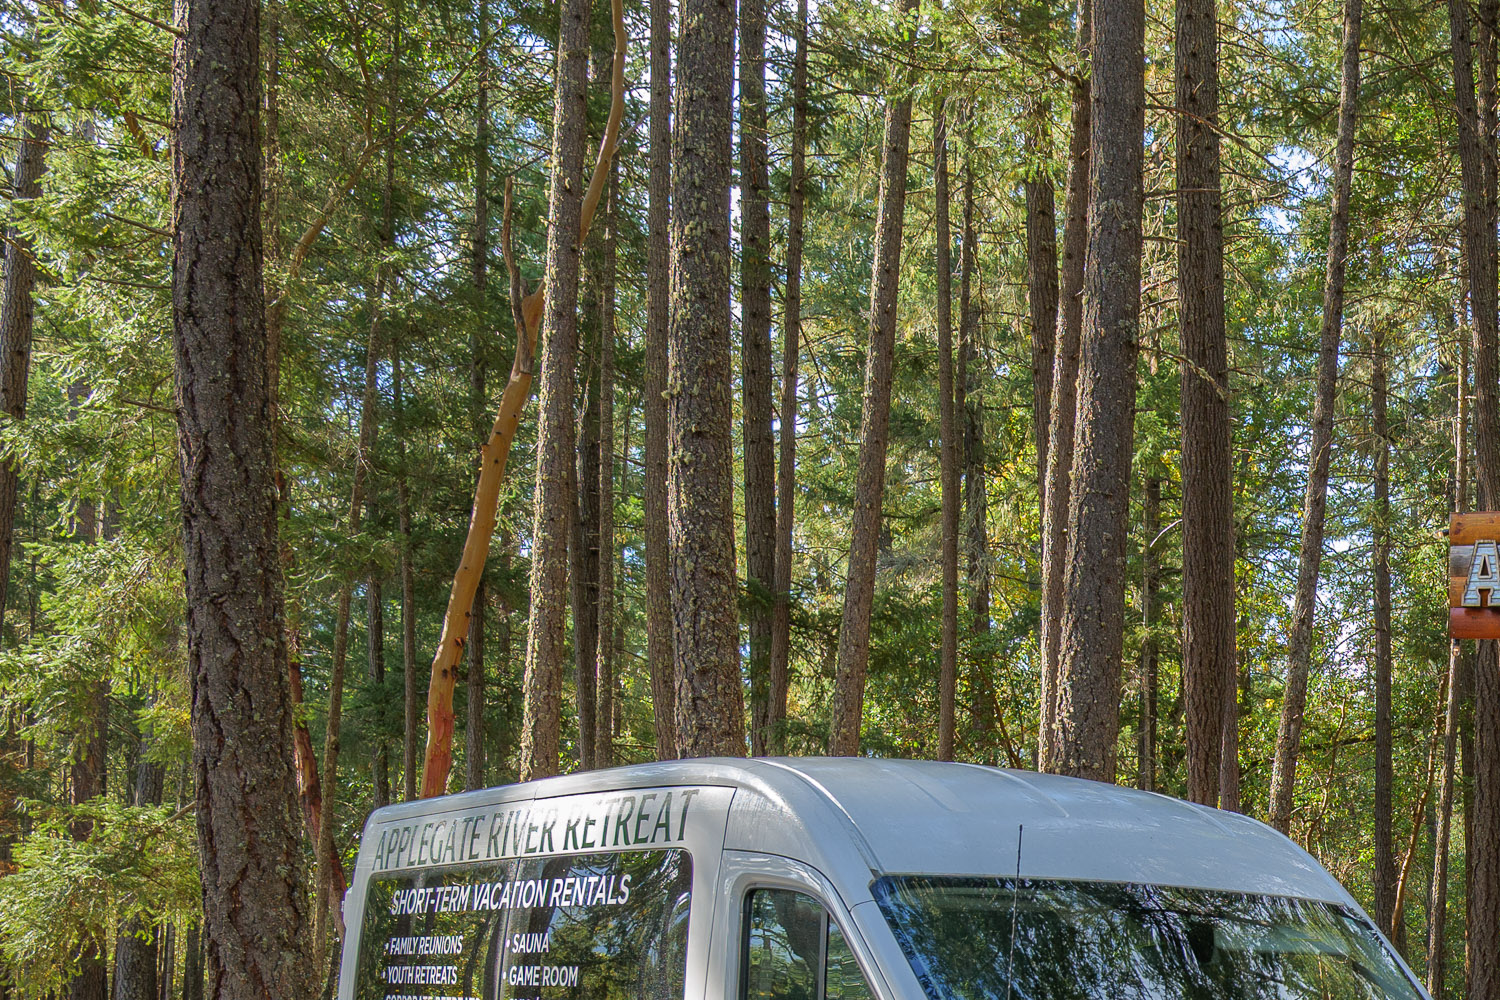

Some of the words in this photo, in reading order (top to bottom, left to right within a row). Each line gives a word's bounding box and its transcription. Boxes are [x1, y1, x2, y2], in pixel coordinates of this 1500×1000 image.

[372, 814, 485, 871] APPLEGATE
[486, 805, 557, 858] RIVER
[563, 789, 700, 851] RETREAT
[391, 883, 471, 915] SHORT-TERM
[472, 878, 547, 911] VACATION
[549, 874, 632, 907] RENTALS
[390, 936, 419, 955] FAMILY
[419, 935, 464, 954] REUNIONS
[512, 933, 549, 953] SAUNA
[387, 966, 413, 984] YOUTH
[414, 966, 458, 985] RETREATS
[509, 965, 540, 986] GAME
[542, 966, 579, 987] ROOM
